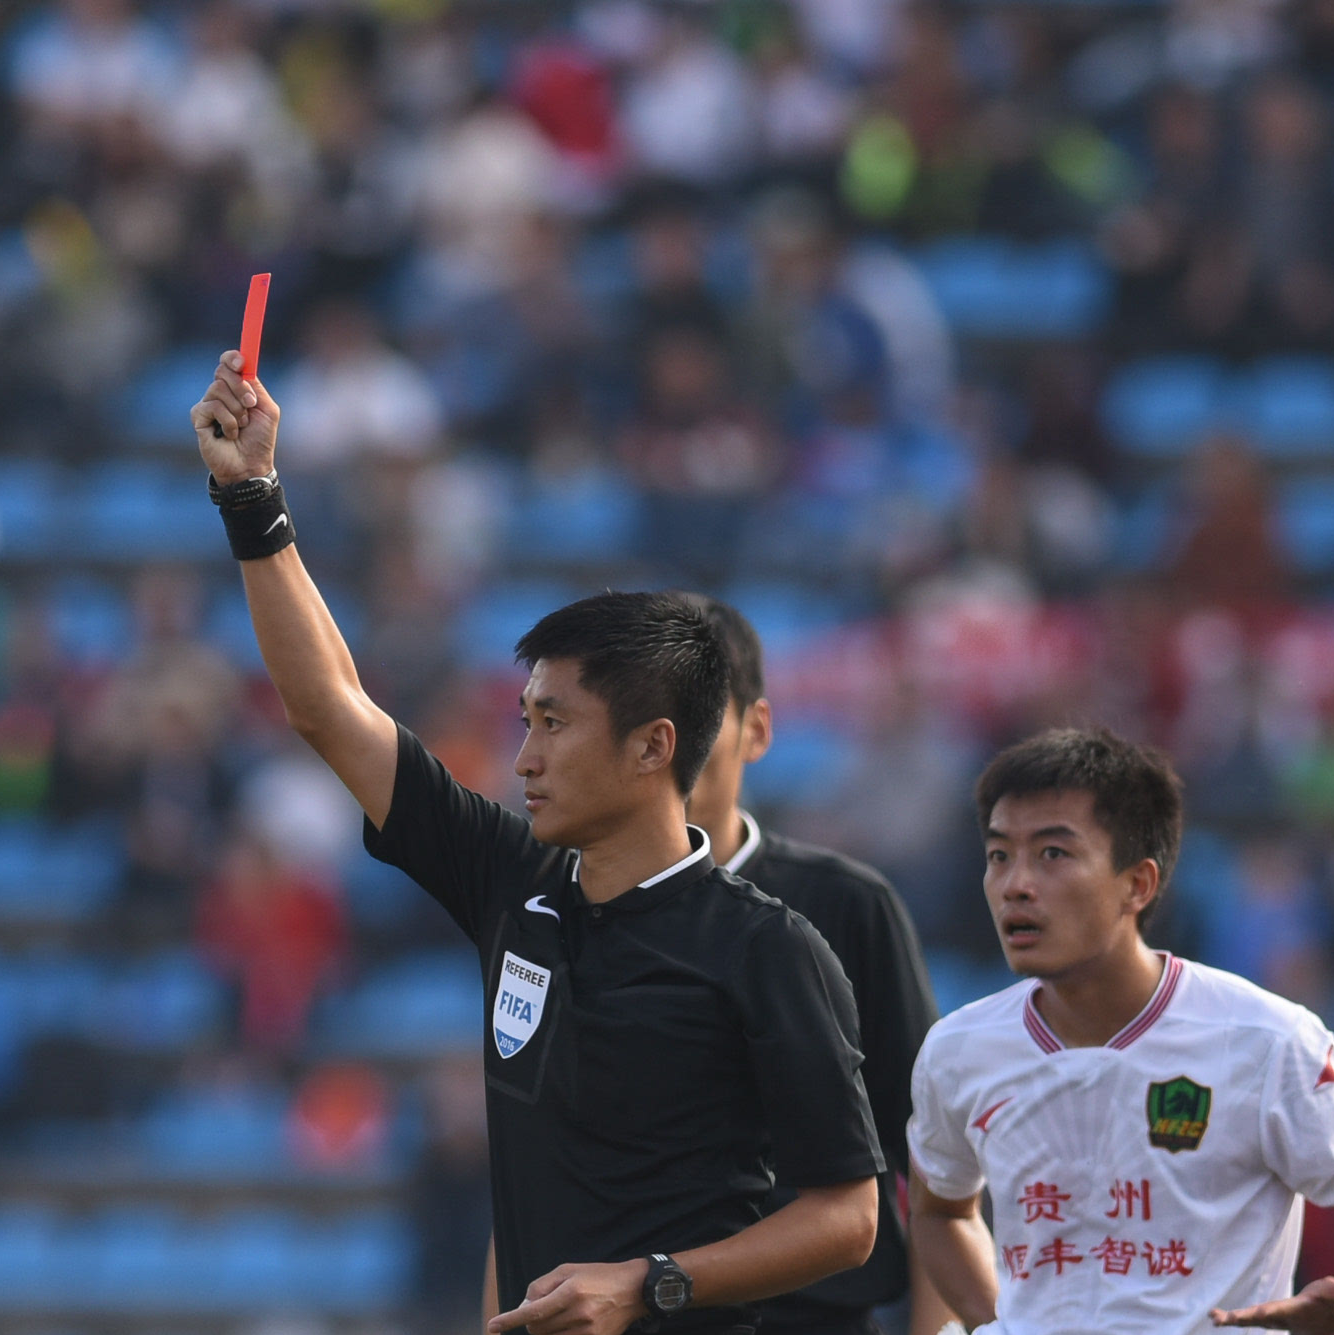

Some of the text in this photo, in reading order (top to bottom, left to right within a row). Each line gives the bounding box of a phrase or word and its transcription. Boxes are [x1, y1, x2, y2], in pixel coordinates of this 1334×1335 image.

[505, 960, 545, 987] REFEREE
[499, 990, 532, 1024] FIFA
[499, 1036, 515, 1051] 2016
[1018, 1179, 1151, 1224] 贵州
